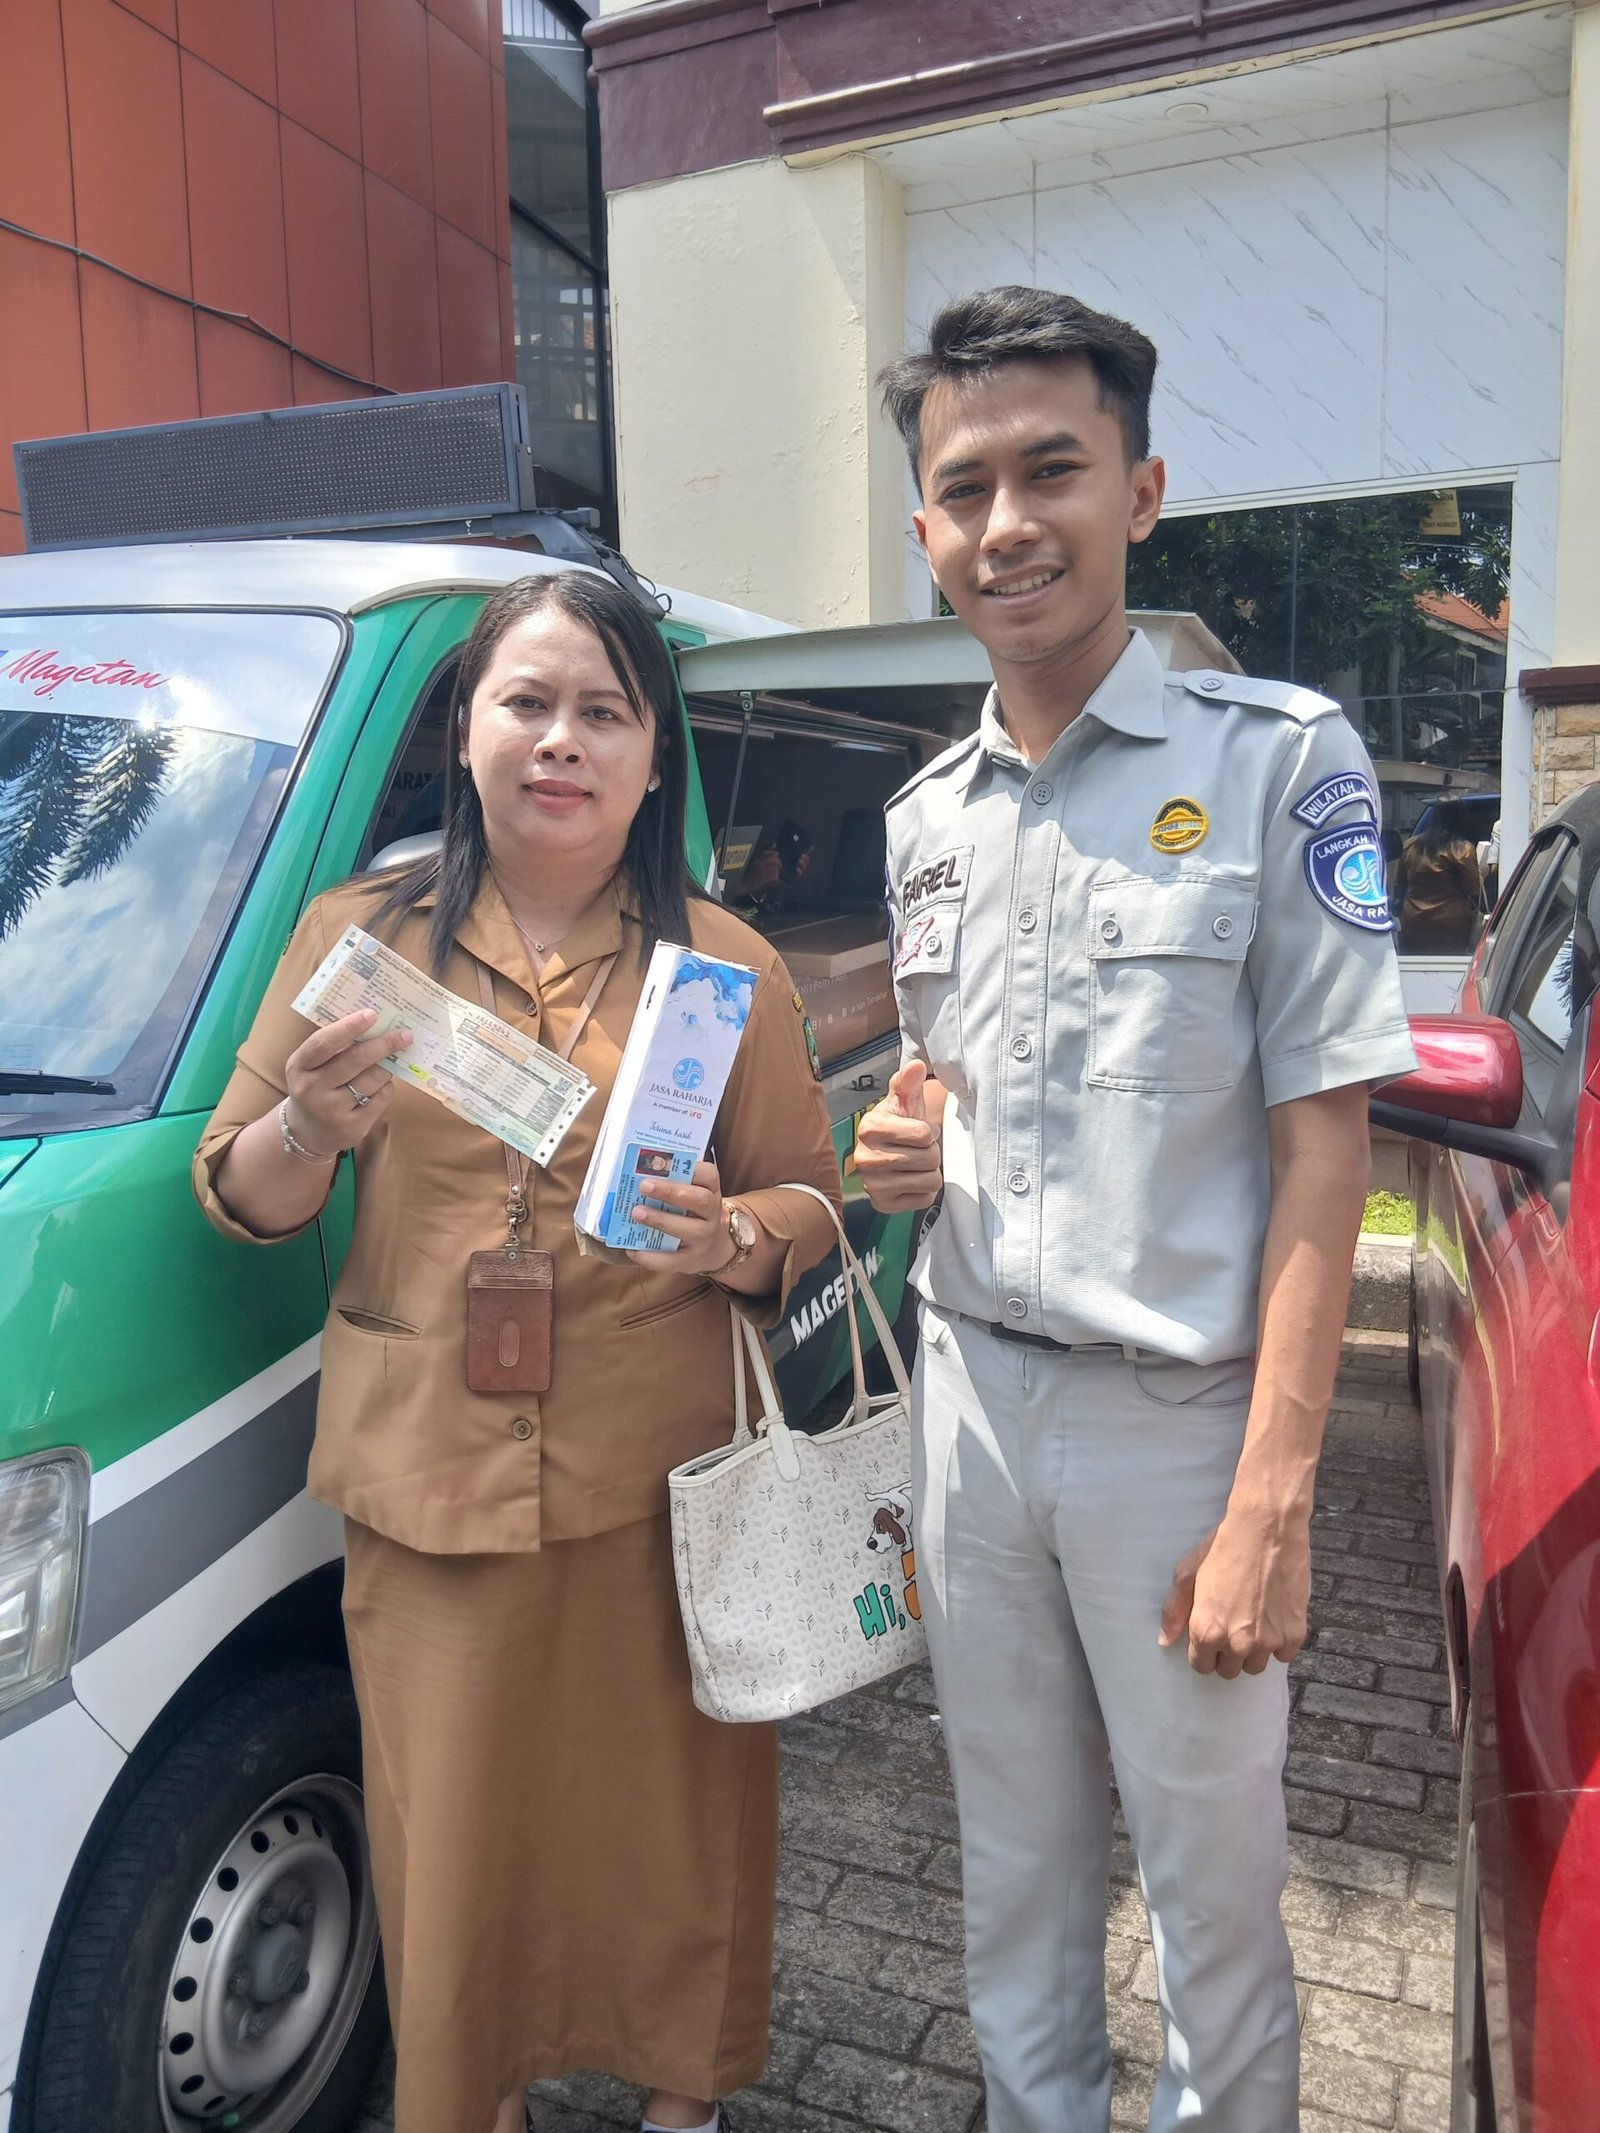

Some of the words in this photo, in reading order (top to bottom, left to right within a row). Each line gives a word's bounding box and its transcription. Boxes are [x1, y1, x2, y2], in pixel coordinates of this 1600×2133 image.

[0, 649, 170, 697] Magetan
[1304, 780, 1356, 818] WILAYAH
[1315, 834, 1368, 859] LANGKAH
[902, 854, 962, 914] FAREL
[1331, 895, 1364, 918] JASA
[649, 1083, 671, 1096] JASA
[672, 1089, 713, 1107] RAHARJA
[659, 1104, 682, 1113] member
[853, 1582, 907, 1641] Hi,
